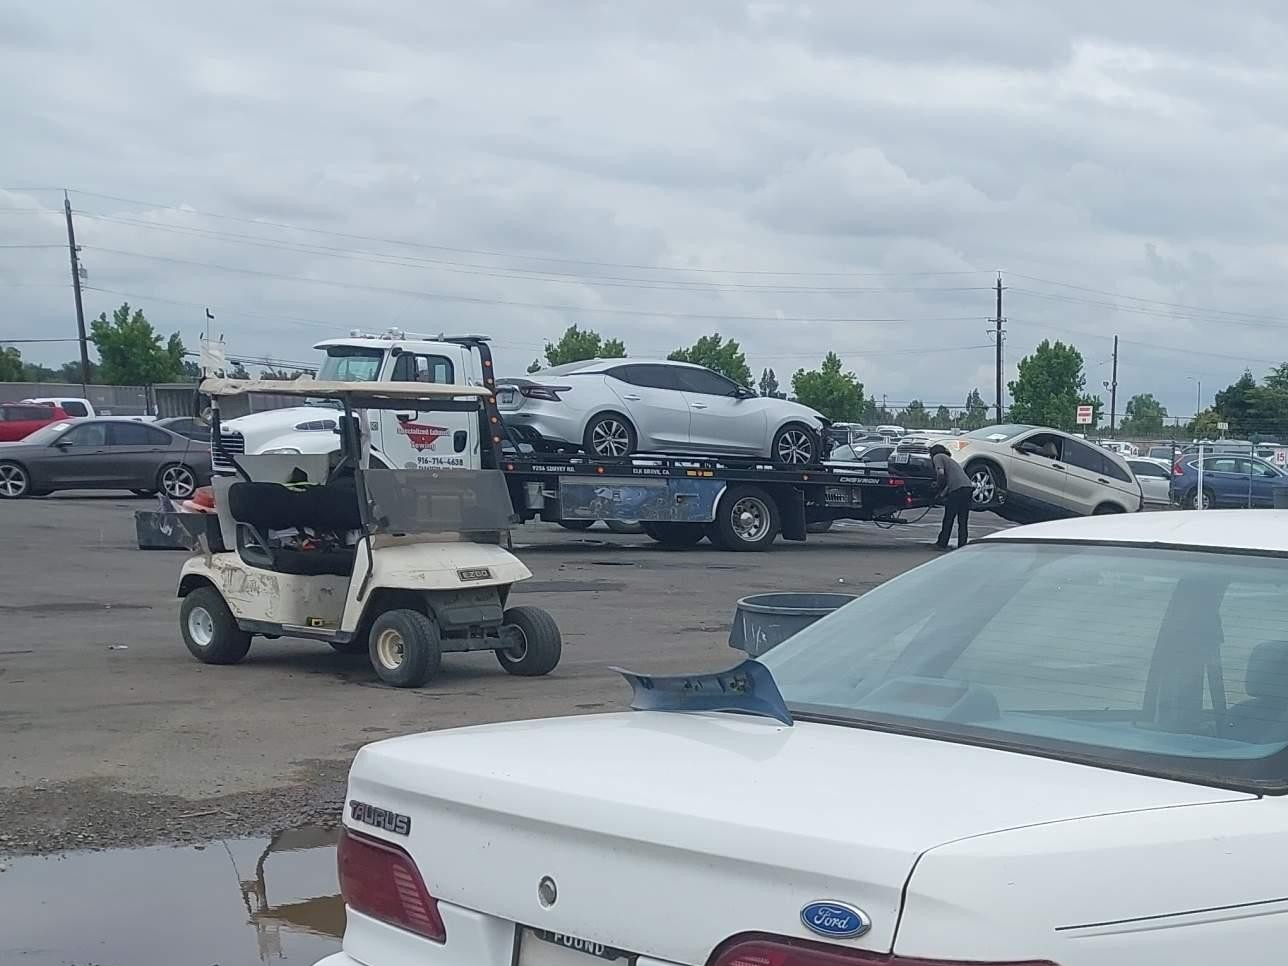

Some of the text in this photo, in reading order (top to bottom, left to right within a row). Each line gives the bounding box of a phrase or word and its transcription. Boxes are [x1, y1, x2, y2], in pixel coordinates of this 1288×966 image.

[1277, 453, 1285, 462] 15
[350, 800, 411, 836] TAURUS
[814, 906, 850, 930] Ford
[554, 932, 605, 955] FOUND
